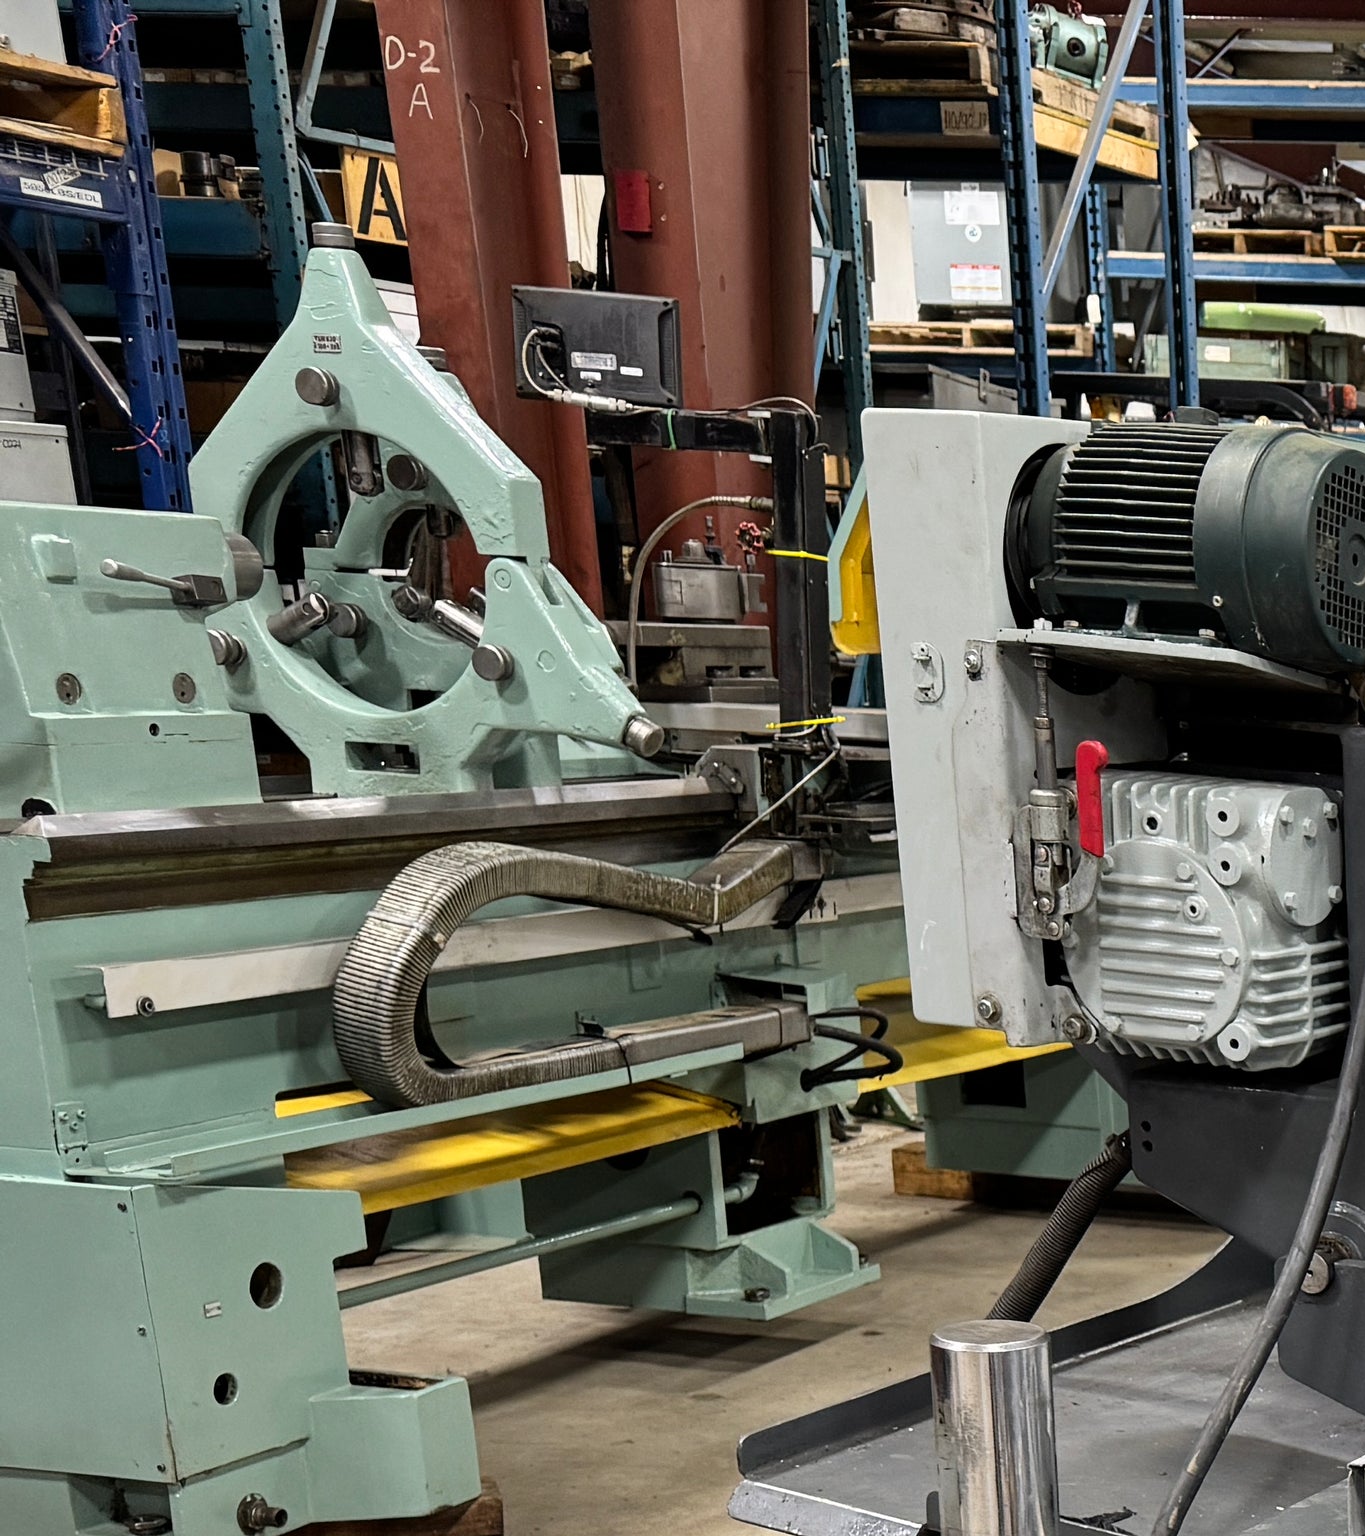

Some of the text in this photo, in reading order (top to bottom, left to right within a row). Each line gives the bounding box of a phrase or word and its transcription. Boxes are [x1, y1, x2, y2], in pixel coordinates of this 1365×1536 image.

[384, 35, 440, 73] D-2
[408, 83, 434, 120] A
[357, 156, 407, 241] A
